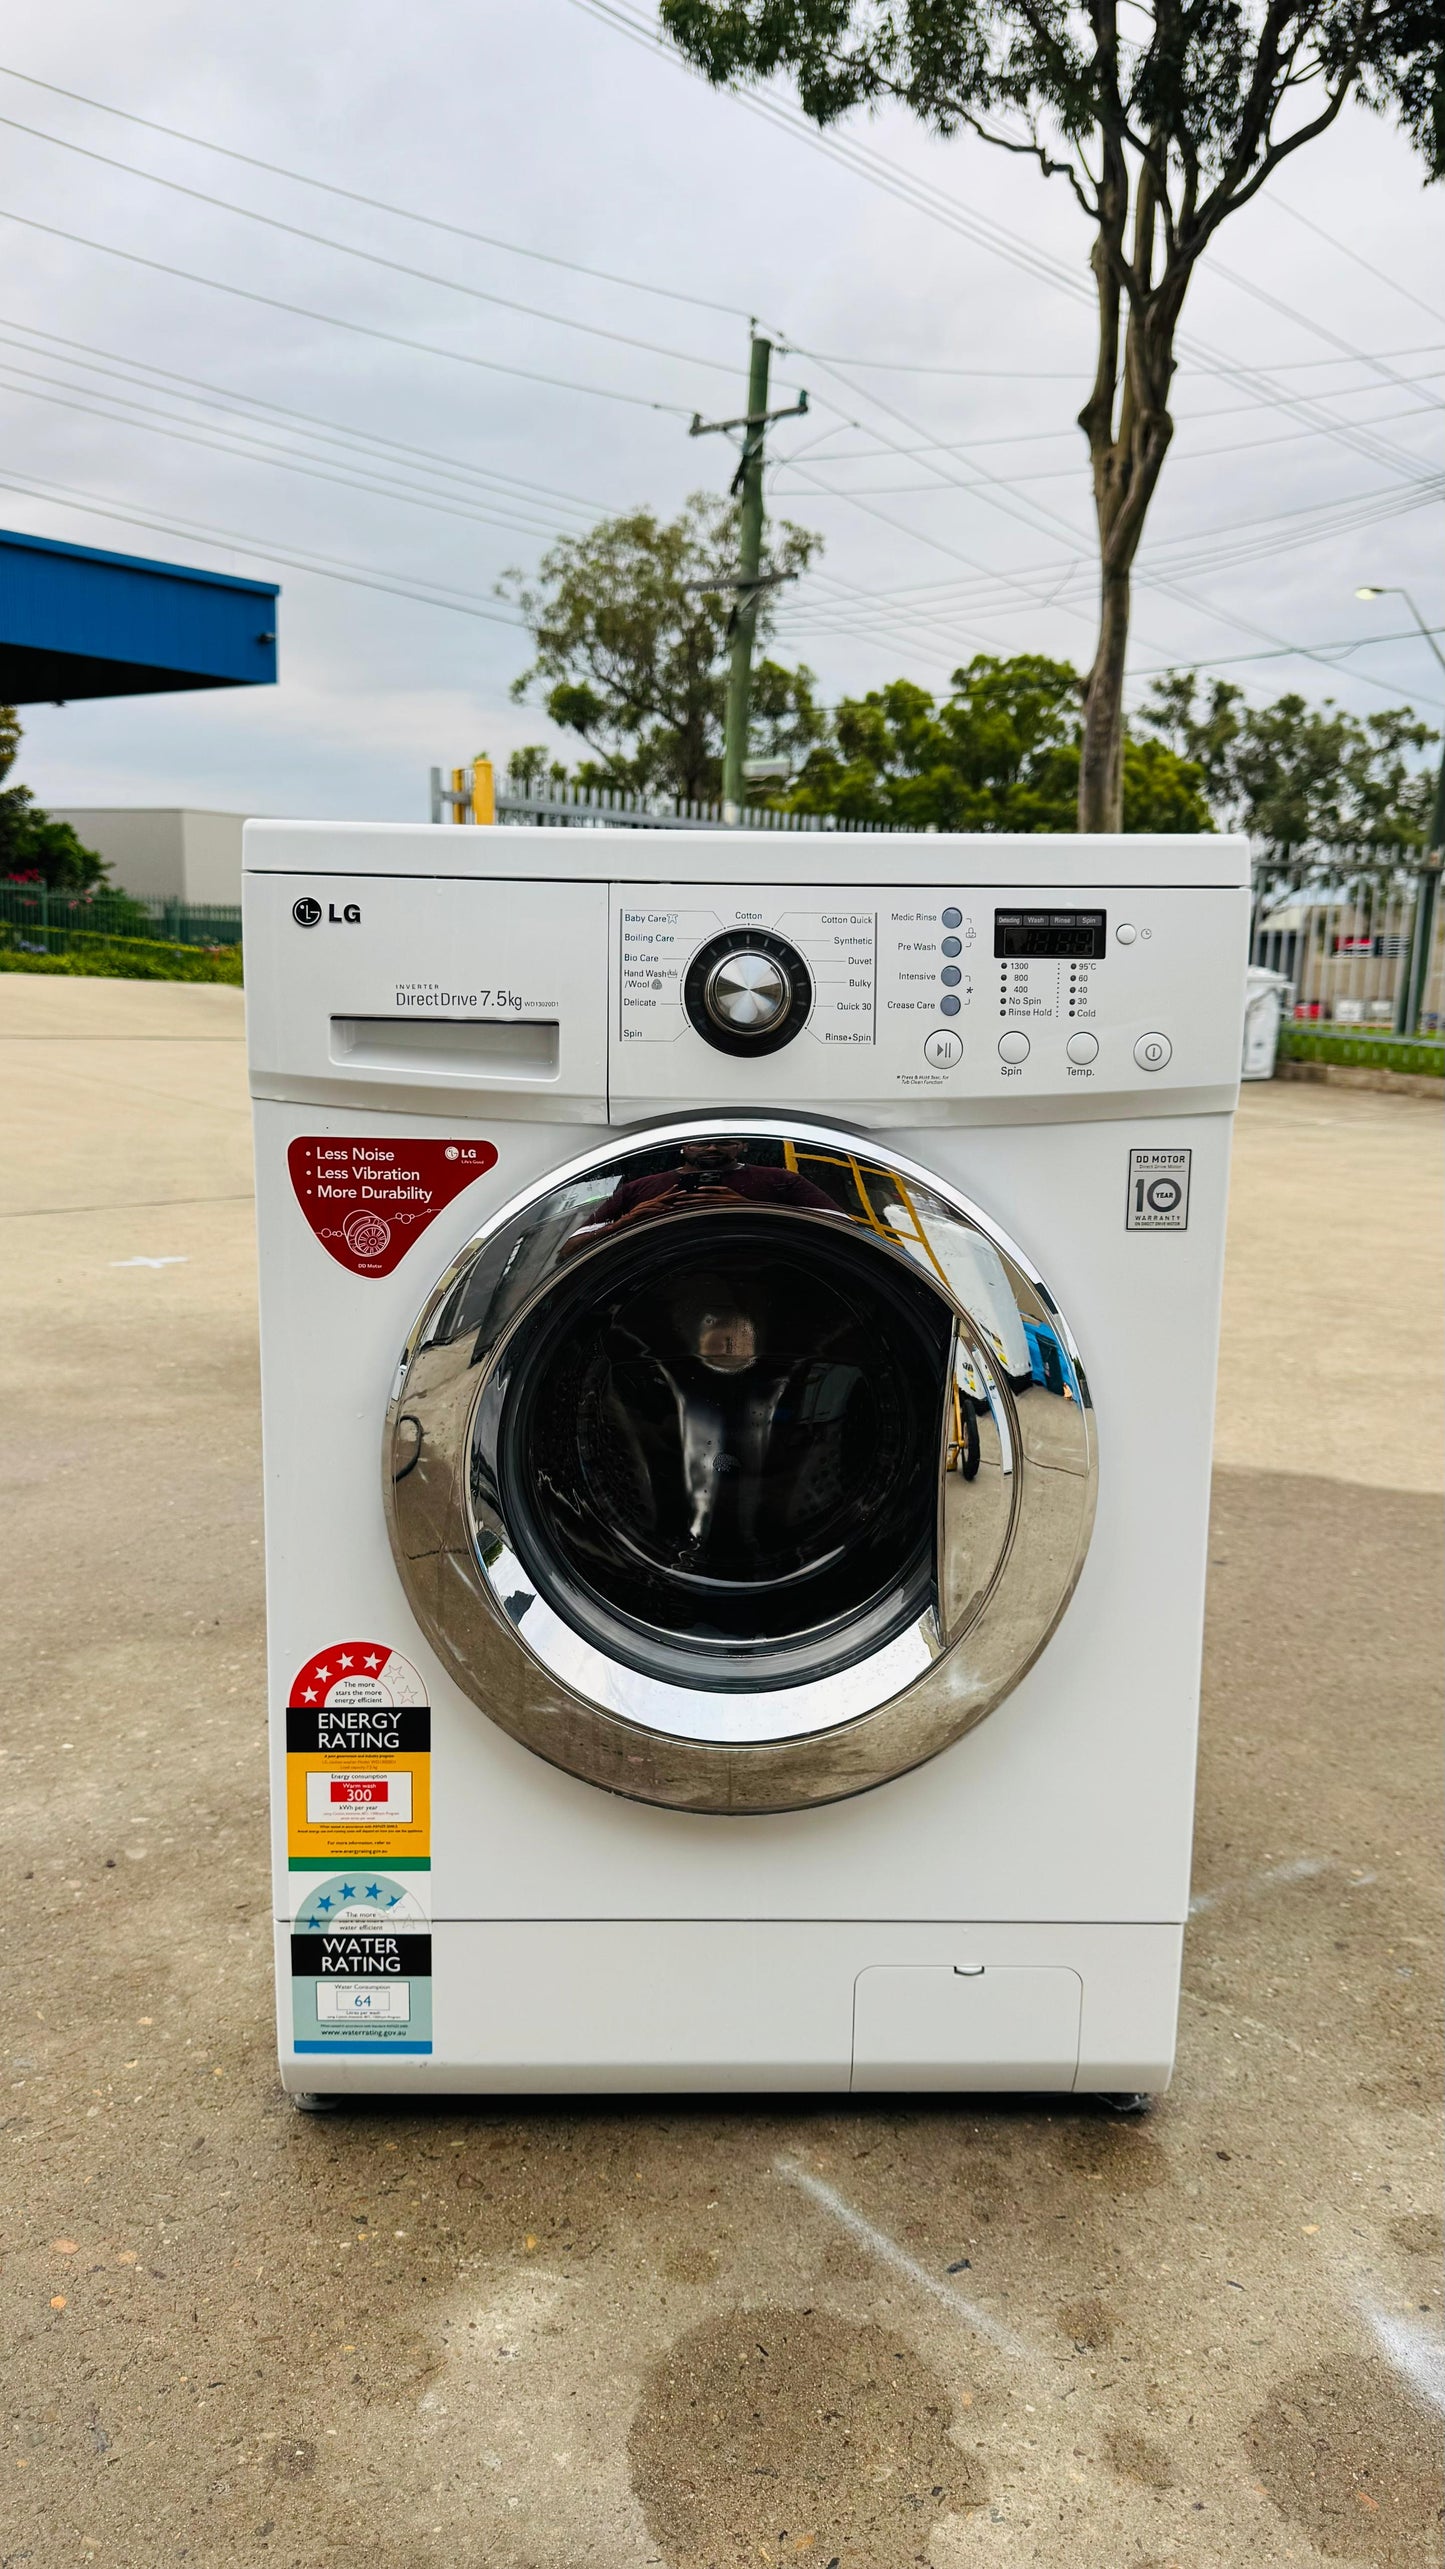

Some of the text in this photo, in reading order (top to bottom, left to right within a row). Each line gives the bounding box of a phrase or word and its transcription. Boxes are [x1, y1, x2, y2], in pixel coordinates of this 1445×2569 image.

[329, 904, 361, 923] LG
[735, 912, 762, 920] Cotton
[891, 913, 914, 921] Medic
[625, 914, 645, 923] Baby
[821, 916, 872, 924] Cotton Quick
[624, 934, 653, 943] Boiling
[834, 937, 872, 946] Synthetic
[640, 954, 659, 962] Care
[848, 957, 872, 965] Duvet
[646, 970, 667, 978] Wash
[899, 972, 936, 980] Intensive
[624, 980, 650, 988] /Wool
[849, 979, 872, 988] Bulky
[624, 998, 656, 1007] Delicate
[887, 1001, 935, 1009] Crease Care
[1023, 998, 1041, 1006] Spin
[624, 1030, 642, 1038] Spin
[1001, 1067, 1022, 1077] Spin
[1067, 1067, 1095, 1077] Temp.
[316, 1147, 394, 1161] Less Noise
[461, 1149, 476, 1158] LG
[317, 1166, 420, 1180] Less Vibration
[317, 1185, 432, 1203] More Durability
[1135, 1178, 1182, 1212] 10
[318, 1713, 402, 1729] ENERGY
[318, 1732, 400, 1749] RATING
[347, 1789, 372, 1801] 300
[322, 1938, 399, 1954] WATER
[322, 1957, 400, 1972] RATING
[354, 1995, 371, 2007] 64
[321, 2029, 406, 2037] www.waterrating.gov.au
